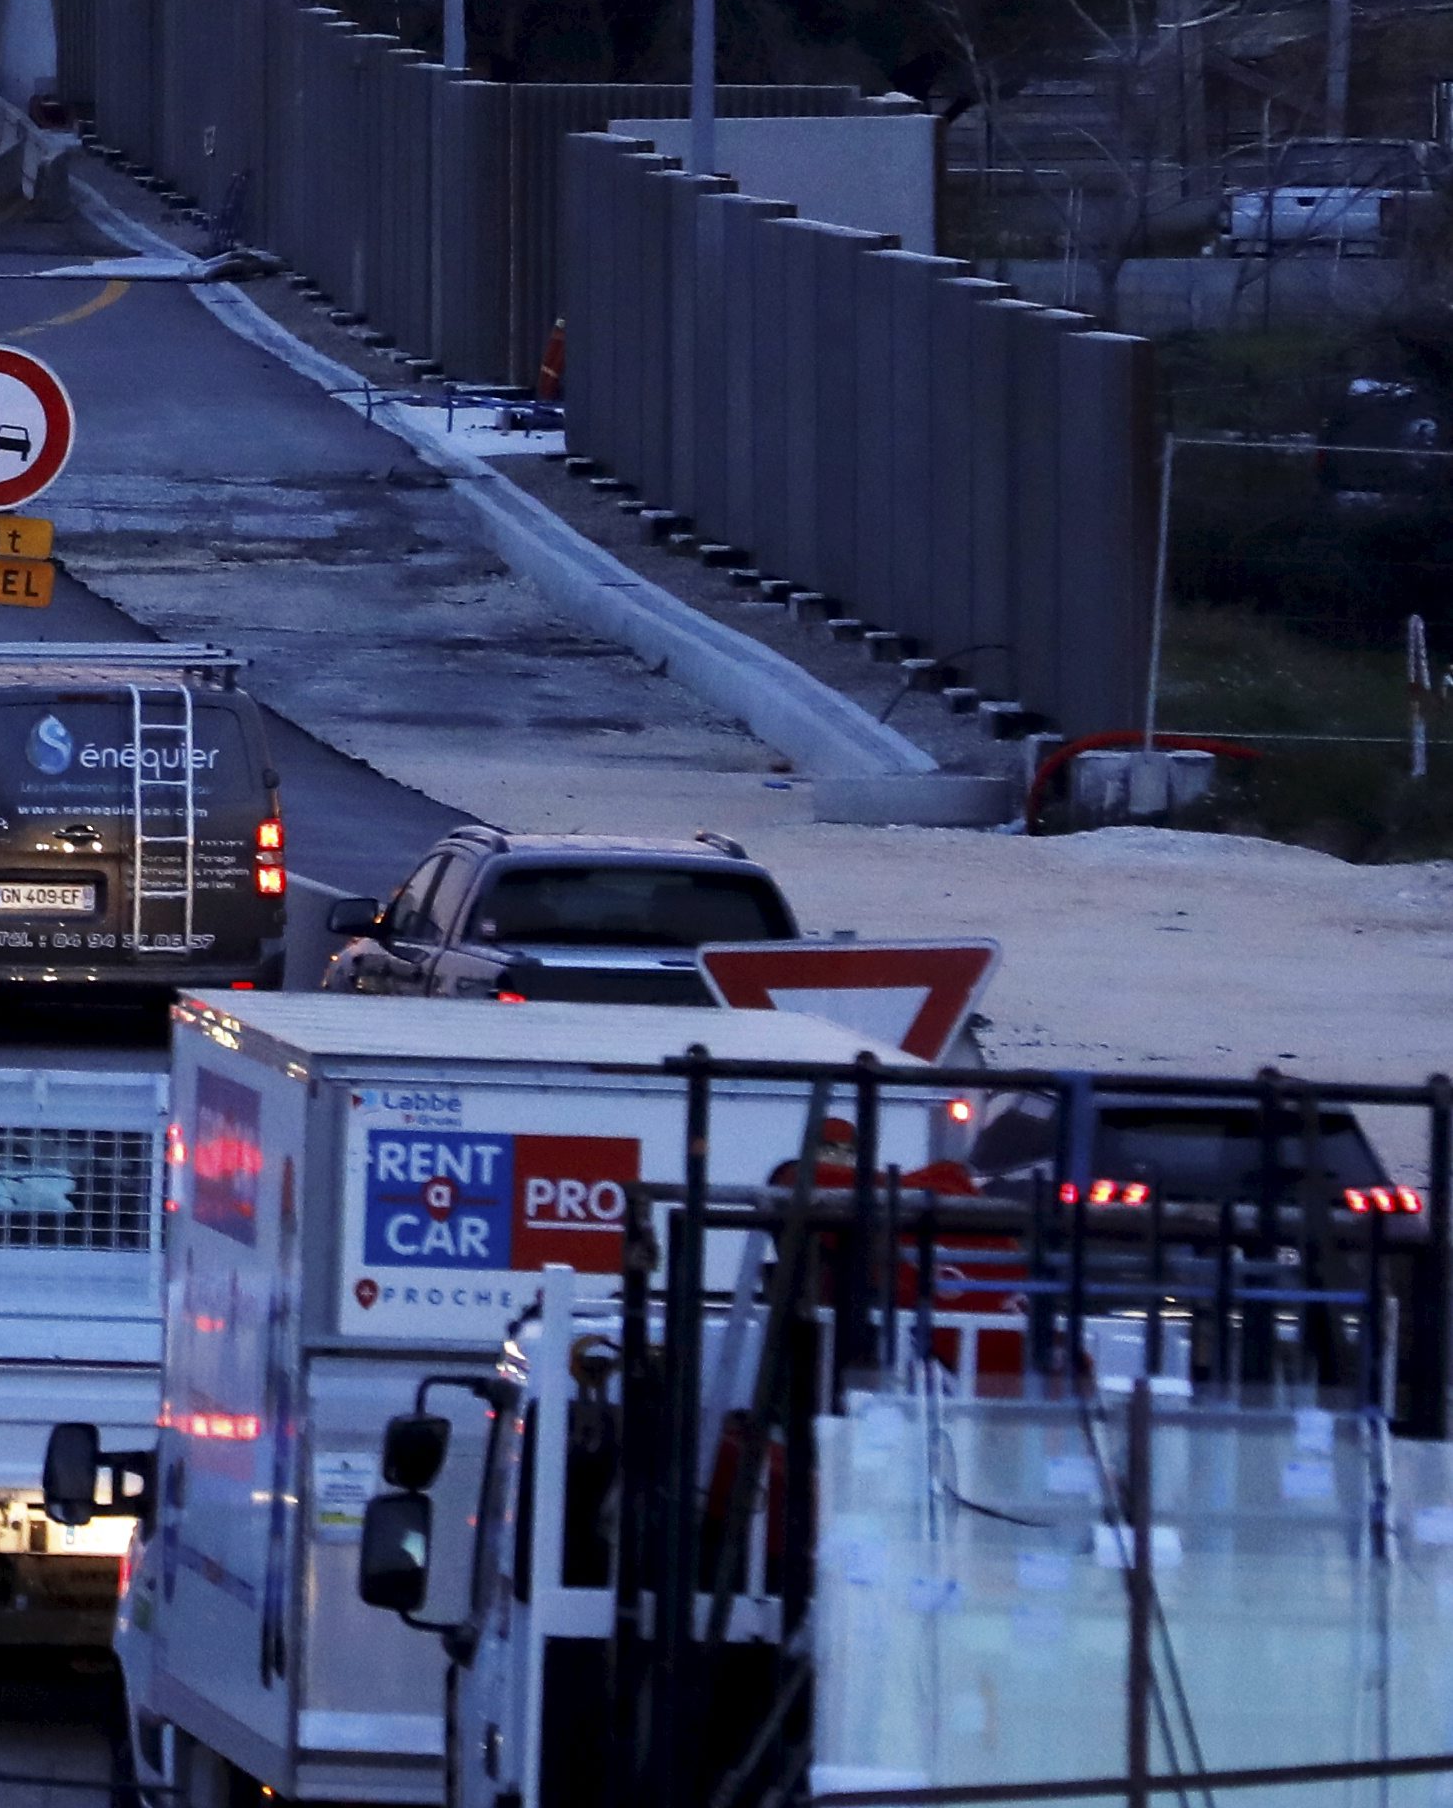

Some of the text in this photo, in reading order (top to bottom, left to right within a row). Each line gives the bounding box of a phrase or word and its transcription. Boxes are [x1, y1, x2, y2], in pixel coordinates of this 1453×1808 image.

[377, 1141, 503, 1185] RENT
[427, 1185, 451, 1208] a
[524, 1177, 627, 1221] PRO
[385, 1213, 490, 1258] CAR
[382, 1287, 513, 1308] PROCHE
